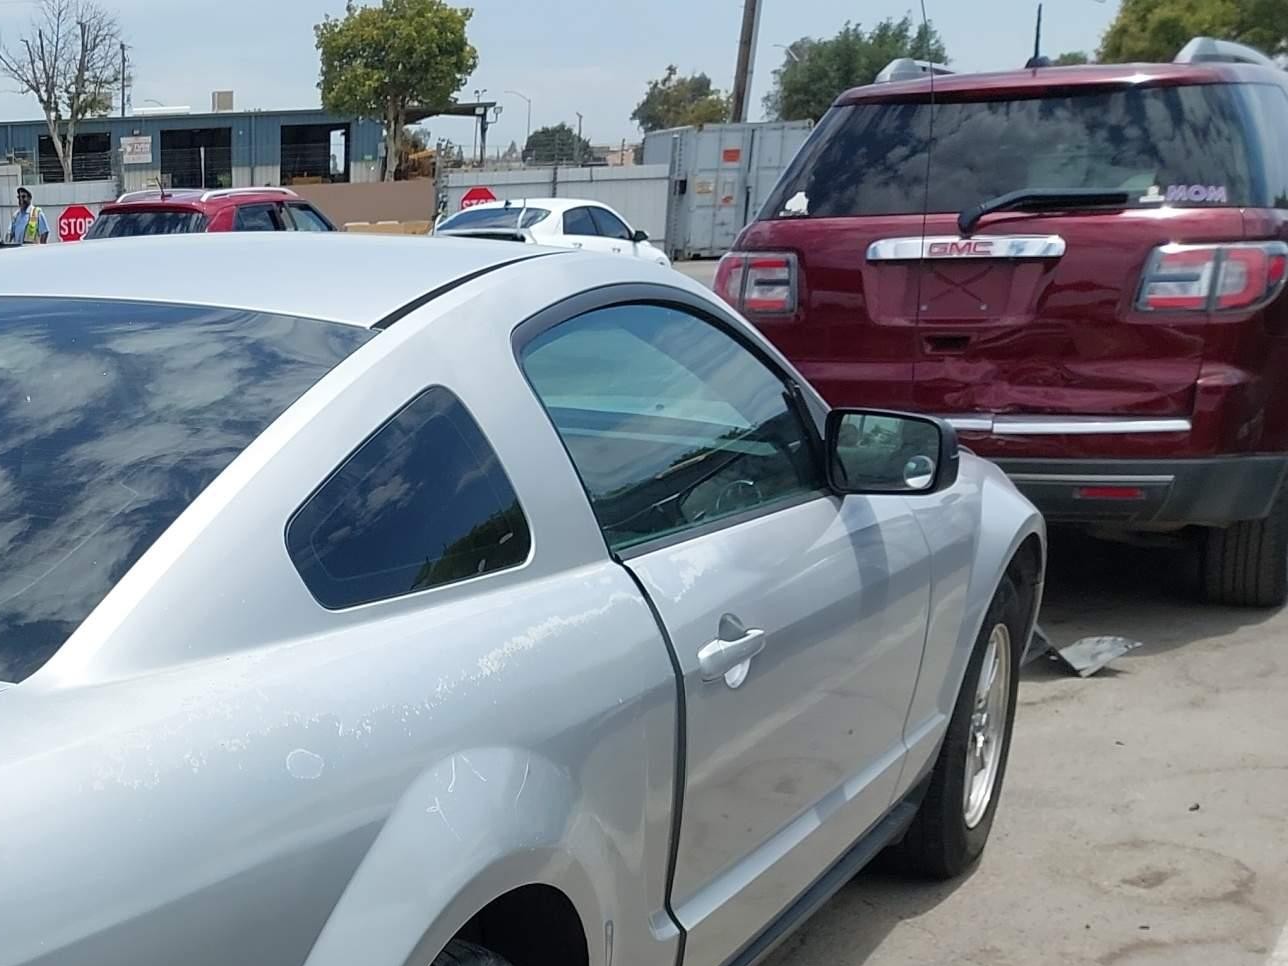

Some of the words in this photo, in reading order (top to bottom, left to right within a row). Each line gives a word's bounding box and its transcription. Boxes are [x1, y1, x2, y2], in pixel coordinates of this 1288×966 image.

[1167, 184, 1226, 203] MOM
[60, 218, 94, 235] STOP
[929, 241, 993, 256] GMC
